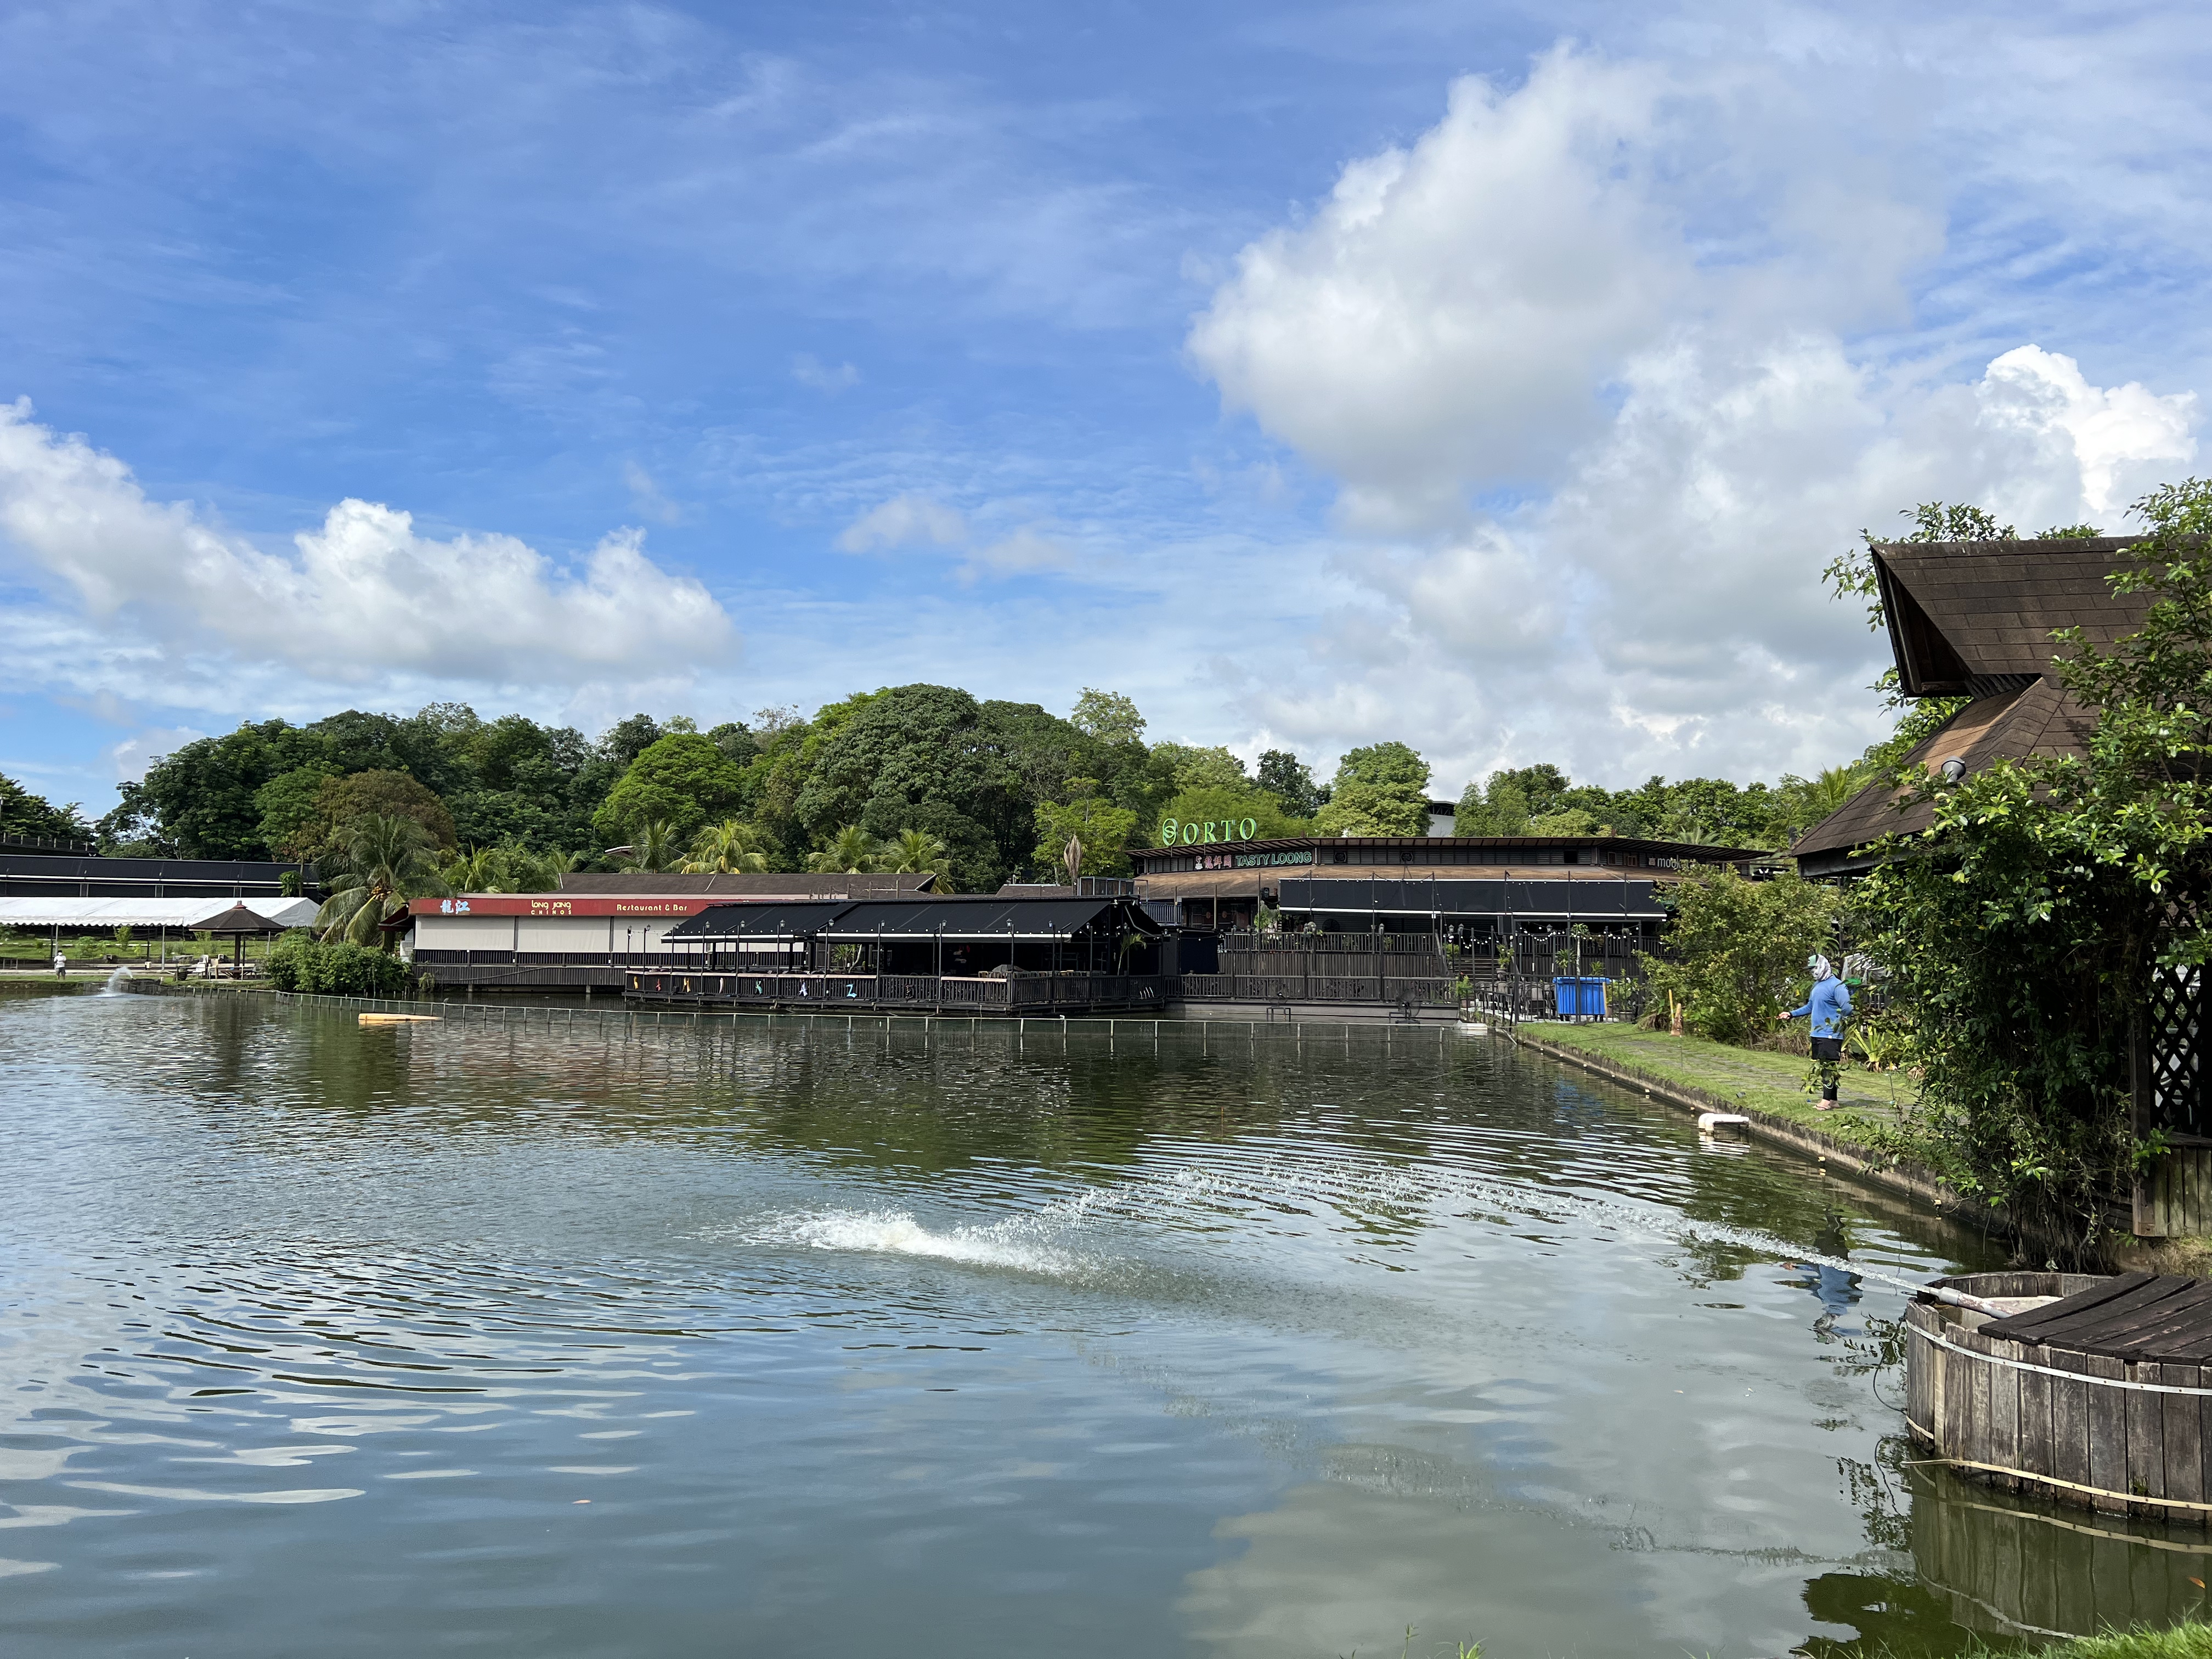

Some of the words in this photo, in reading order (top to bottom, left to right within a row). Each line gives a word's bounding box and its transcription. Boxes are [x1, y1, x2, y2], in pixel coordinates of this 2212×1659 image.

[1183, 817, 1256, 844] ORTO
[1235, 854, 1270, 866] TASTY
[1272, 851, 1312, 865] LOONG
